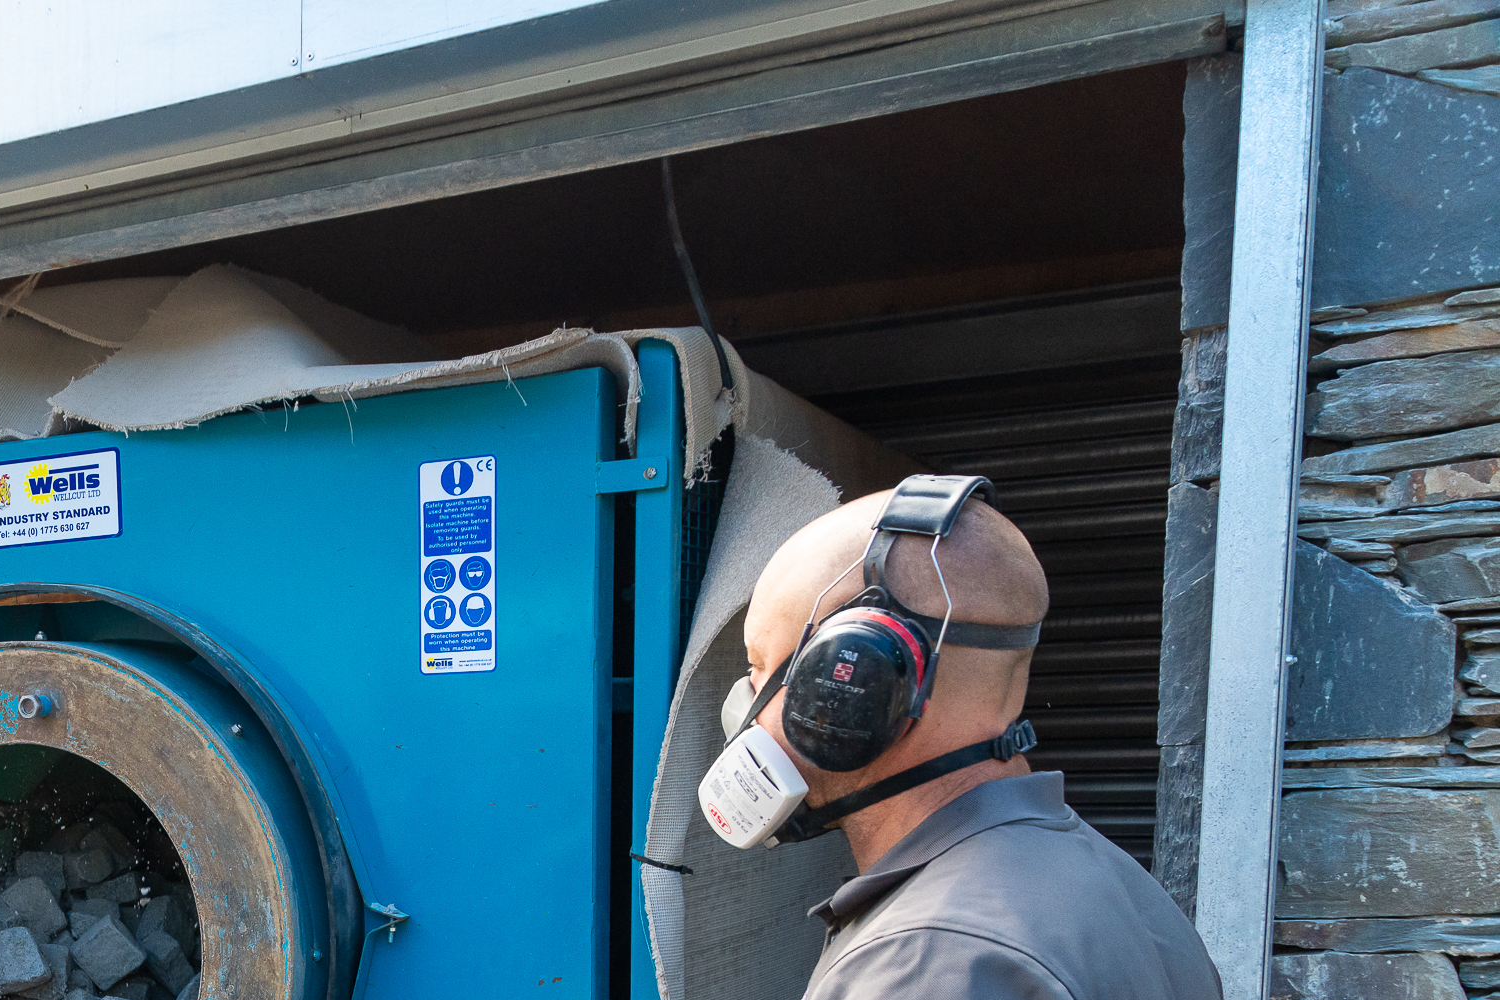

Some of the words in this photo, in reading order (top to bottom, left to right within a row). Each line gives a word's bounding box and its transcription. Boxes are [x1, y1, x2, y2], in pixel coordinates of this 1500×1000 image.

[29, 471, 101, 496] Wells
[52, 490, 87, 502] WELLCUT
[87, 489, 101, 499] LTD
[445, 500, 465, 508] guards
[52, 505, 111, 520] STANDARD
[12, 528, 26, 538] +44
[27, 527, 38, 538] (0)
[40, 525, 59, 535] 1775
[60, 523, 74, 533] 630
[76, 521, 90, 531] 627
[426, 660, 453, 668] Wells
[710, 808, 729, 828] JSP
